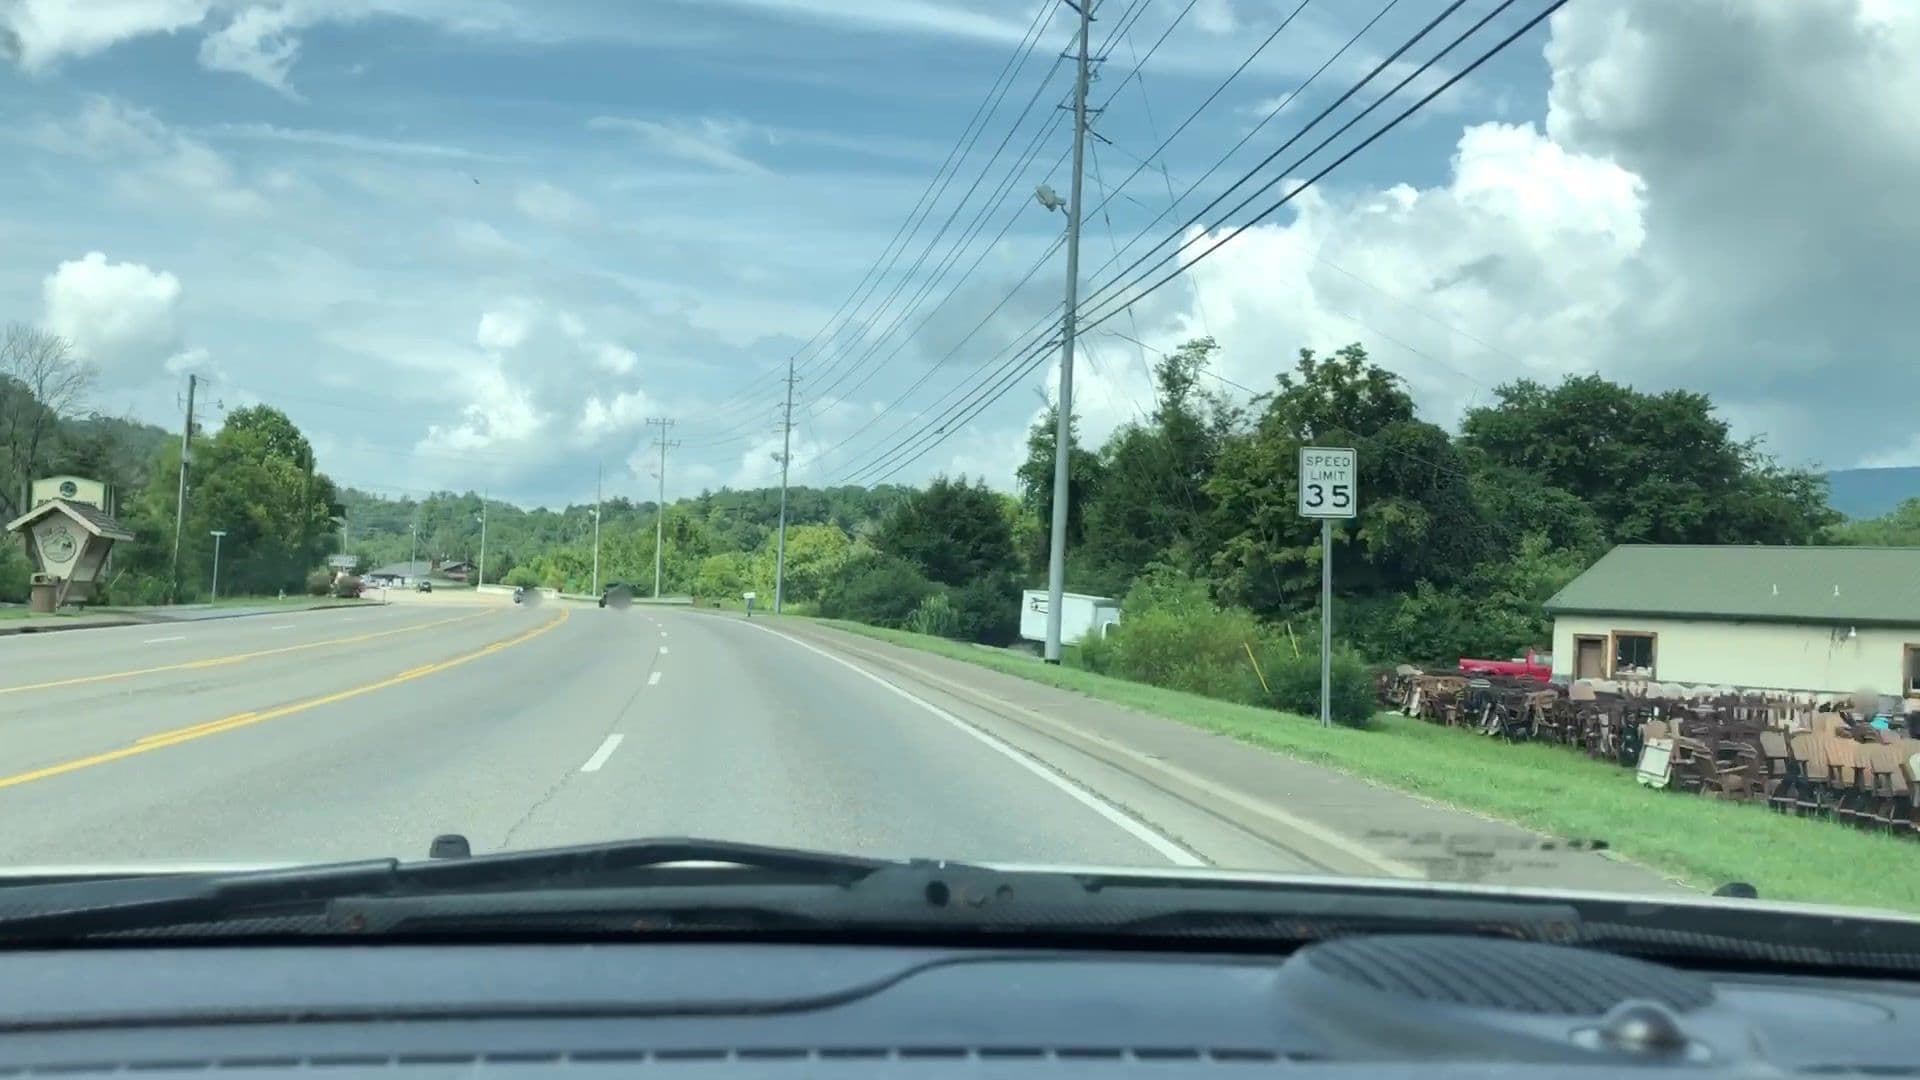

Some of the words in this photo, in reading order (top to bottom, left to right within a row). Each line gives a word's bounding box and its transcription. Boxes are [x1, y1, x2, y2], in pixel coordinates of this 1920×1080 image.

[1305, 456, 1351, 467] SPEED
[1311, 471, 1345, 480] LIMIT
[1305, 484, 1350, 508] 35
